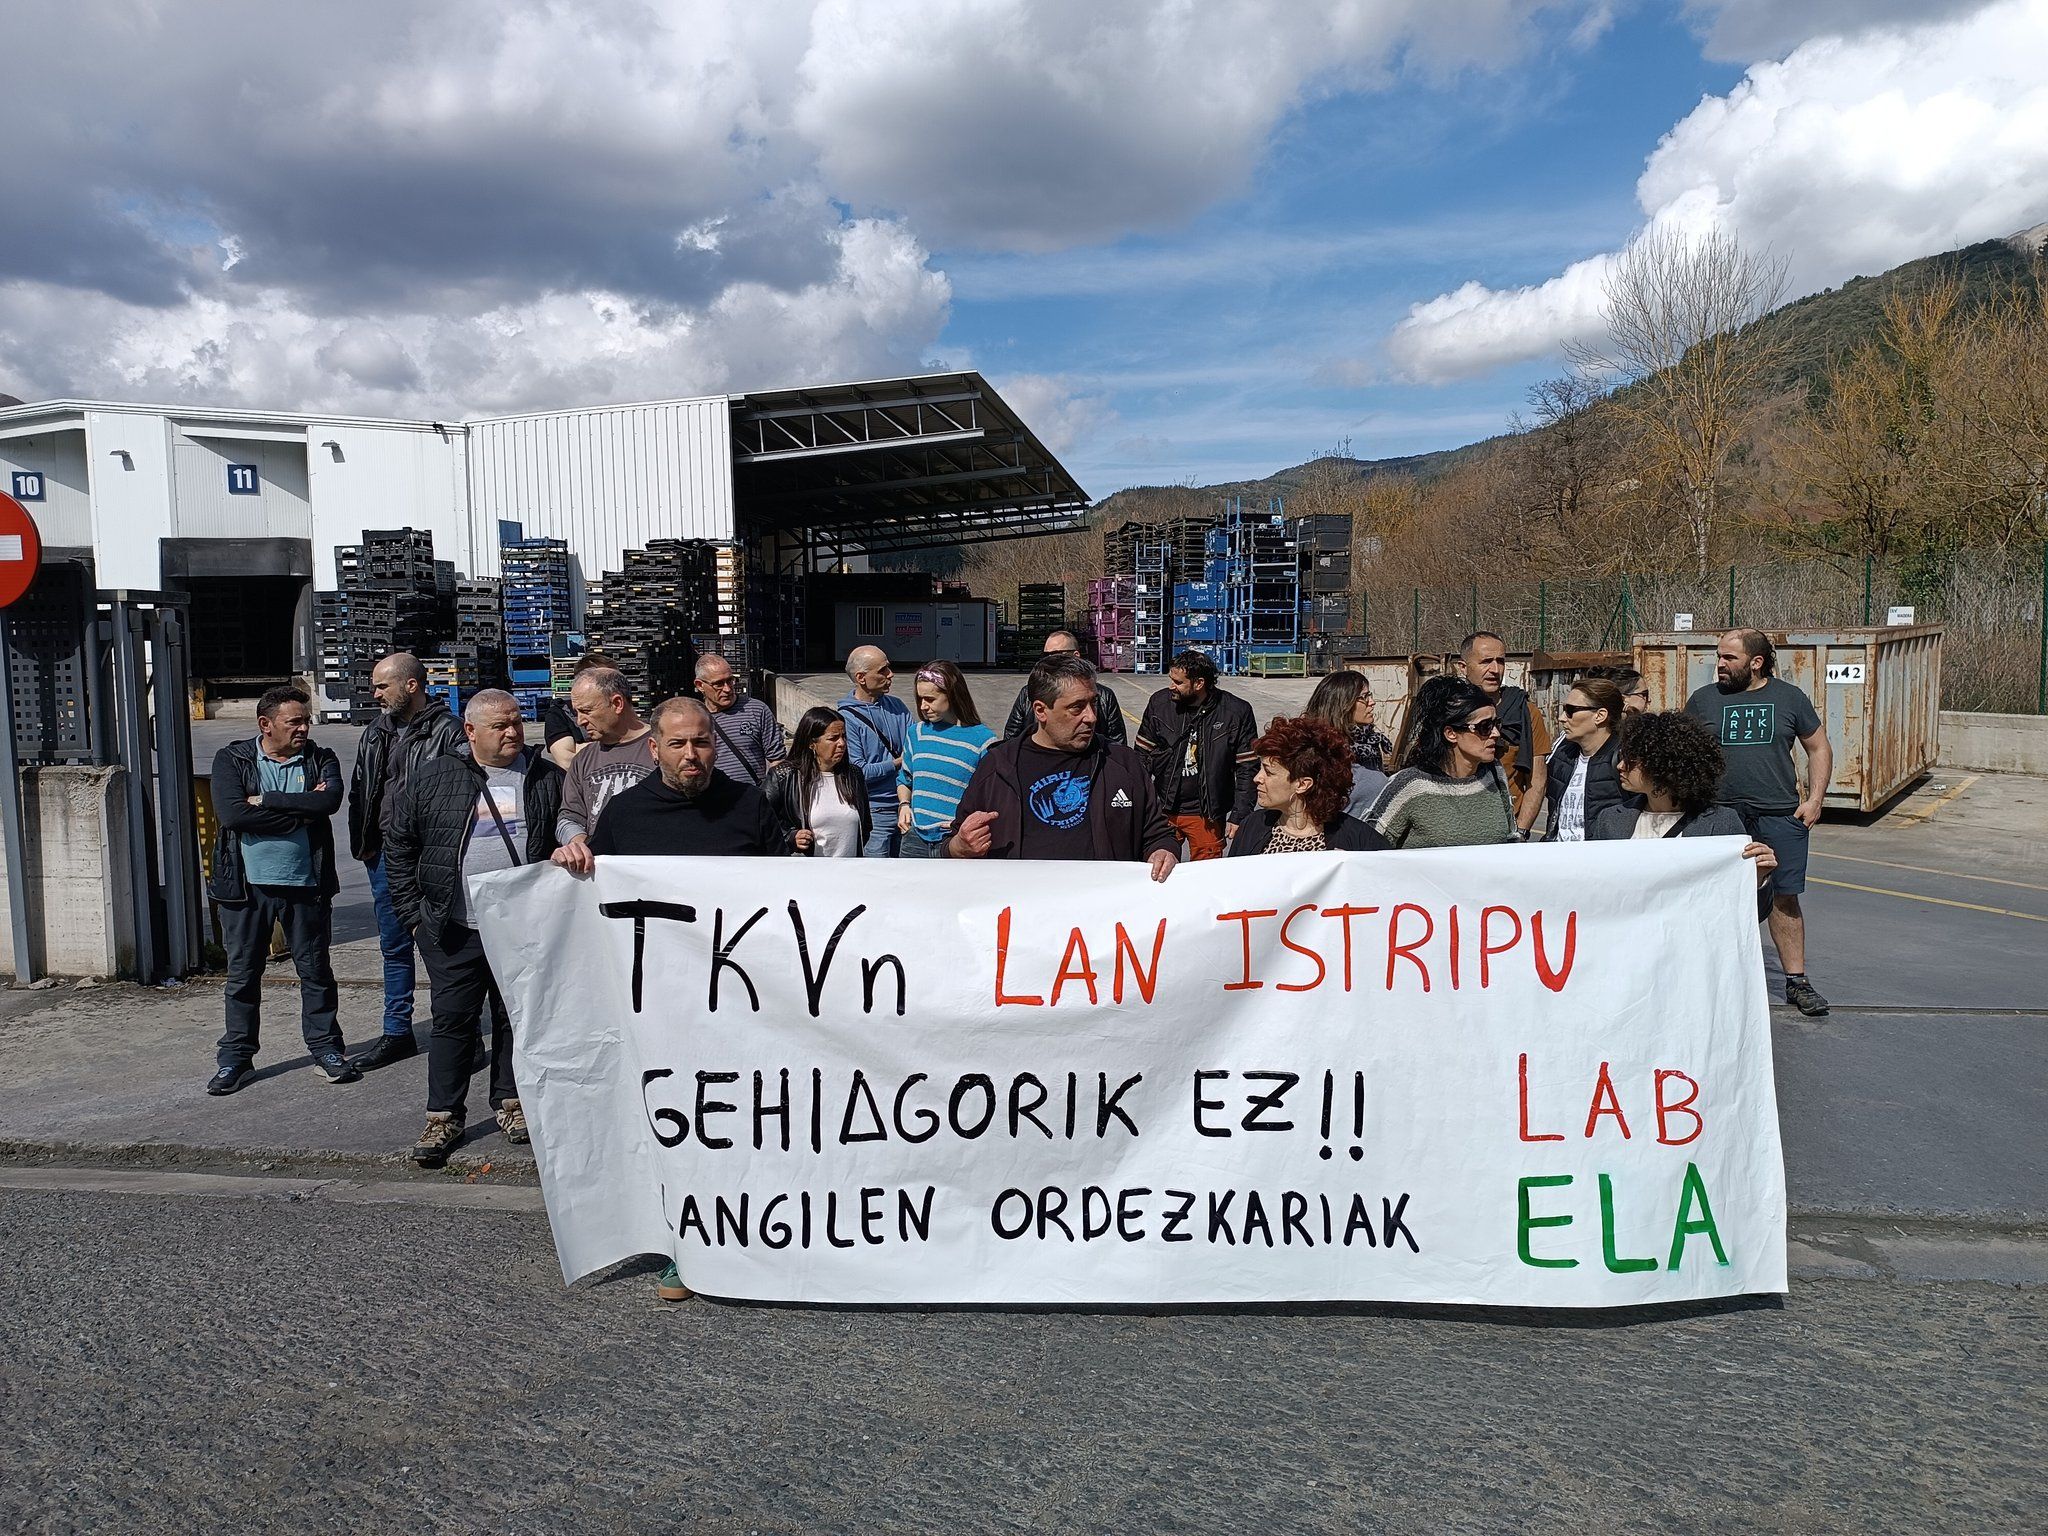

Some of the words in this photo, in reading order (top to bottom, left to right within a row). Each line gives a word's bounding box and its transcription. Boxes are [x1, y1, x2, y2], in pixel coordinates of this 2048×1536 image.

[16, 475, 40, 496] 10
[234, 468, 253, 489] 11
[1029, 770, 1071, 793] HIRU
[599, 899, 906, 1017] TKVn
[995, 906, 1166, 1006] LAN
[1216, 903, 1577, 993] ISTRIPU
[641, 1067, 1143, 1155] GEHIAGORIK
[1194, 1068, 1365, 1161] EZ!!
[1518, 1053, 1703, 1145] LAB
[661, 1183, 936, 1249] ANGILEN
[991, 1186, 1420, 1254] ORDEZKARIAK
[1517, 1162, 1732, 1274] ELA
